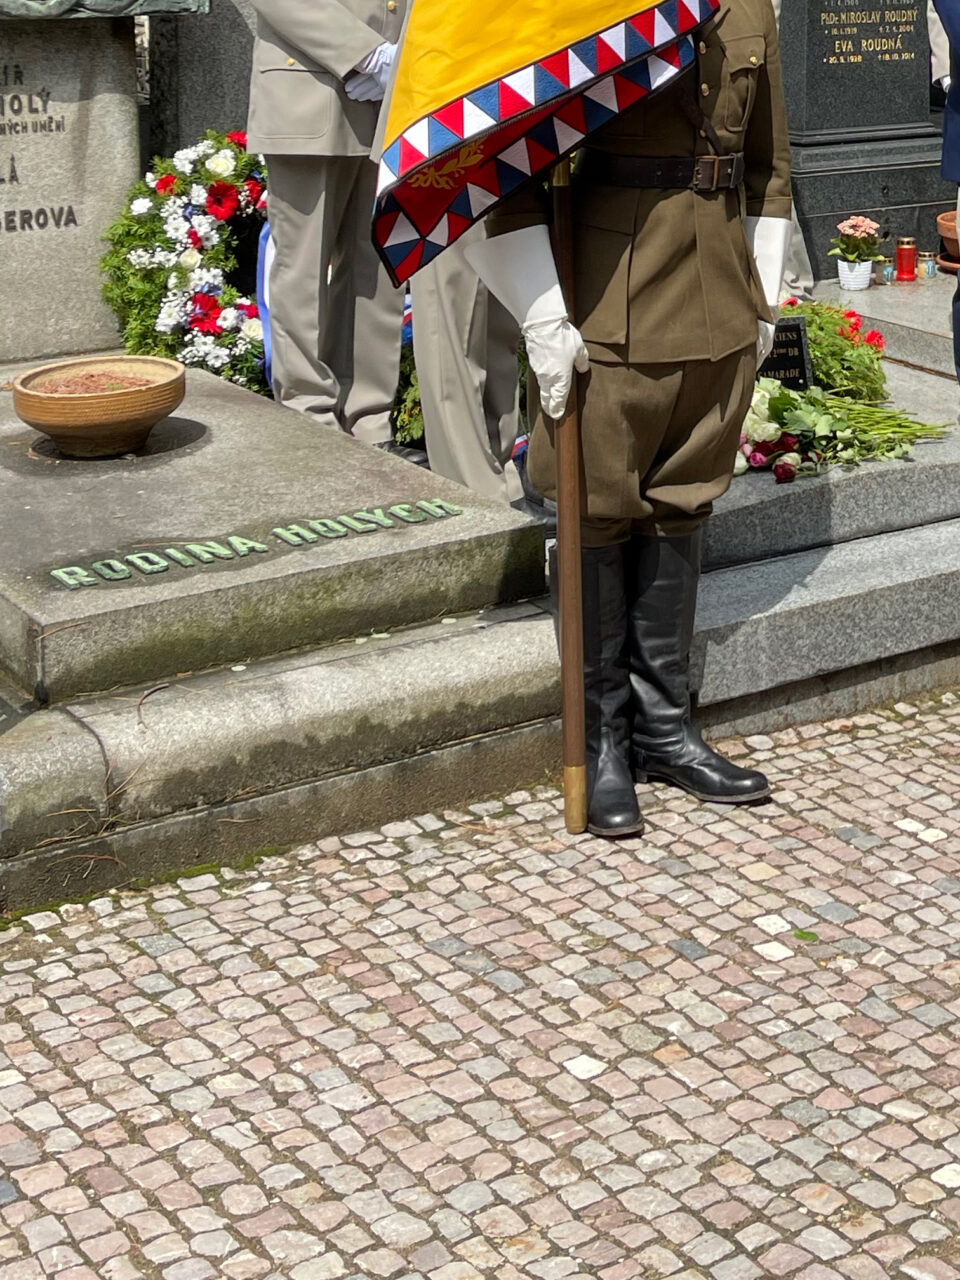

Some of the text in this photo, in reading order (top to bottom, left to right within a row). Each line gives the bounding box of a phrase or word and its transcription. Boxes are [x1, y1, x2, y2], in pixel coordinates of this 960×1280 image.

[840, 10, 881, 24] MIROSLAV
[884, 6, 918, 23] ROUDNÝ
[834, 33, 903, 53] EVA ROUDNÁ
[0, 205, 78, 233] EROVA
[775, 331, 798, 341] CIENS
[50, 497, 462, 590] RODINA HOLÝCH
